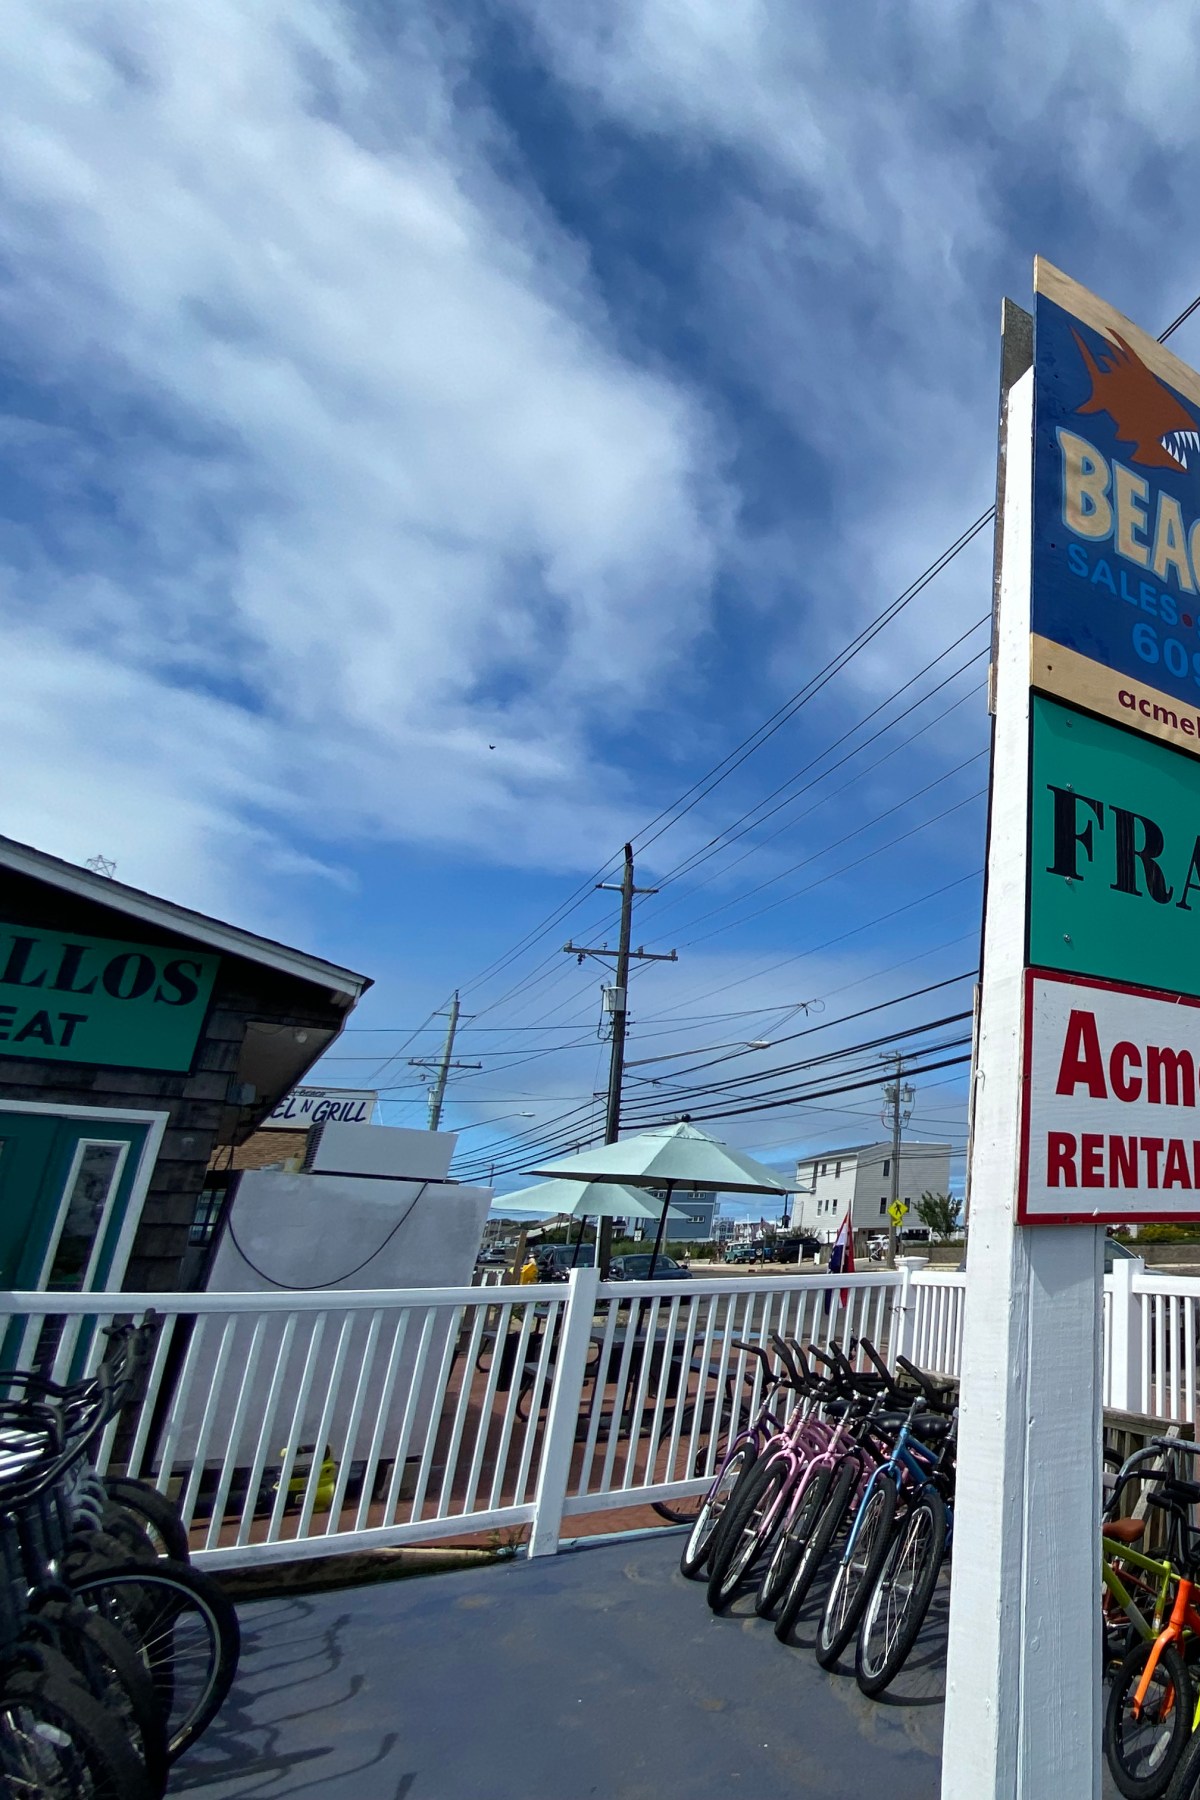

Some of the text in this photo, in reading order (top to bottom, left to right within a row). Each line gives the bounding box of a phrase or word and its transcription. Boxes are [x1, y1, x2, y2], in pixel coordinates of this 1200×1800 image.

[1067, 543, 1179, 626] SALES
[300, 1099, 314, 1113] N
[311, 1100, 366, 1123] GRILL
